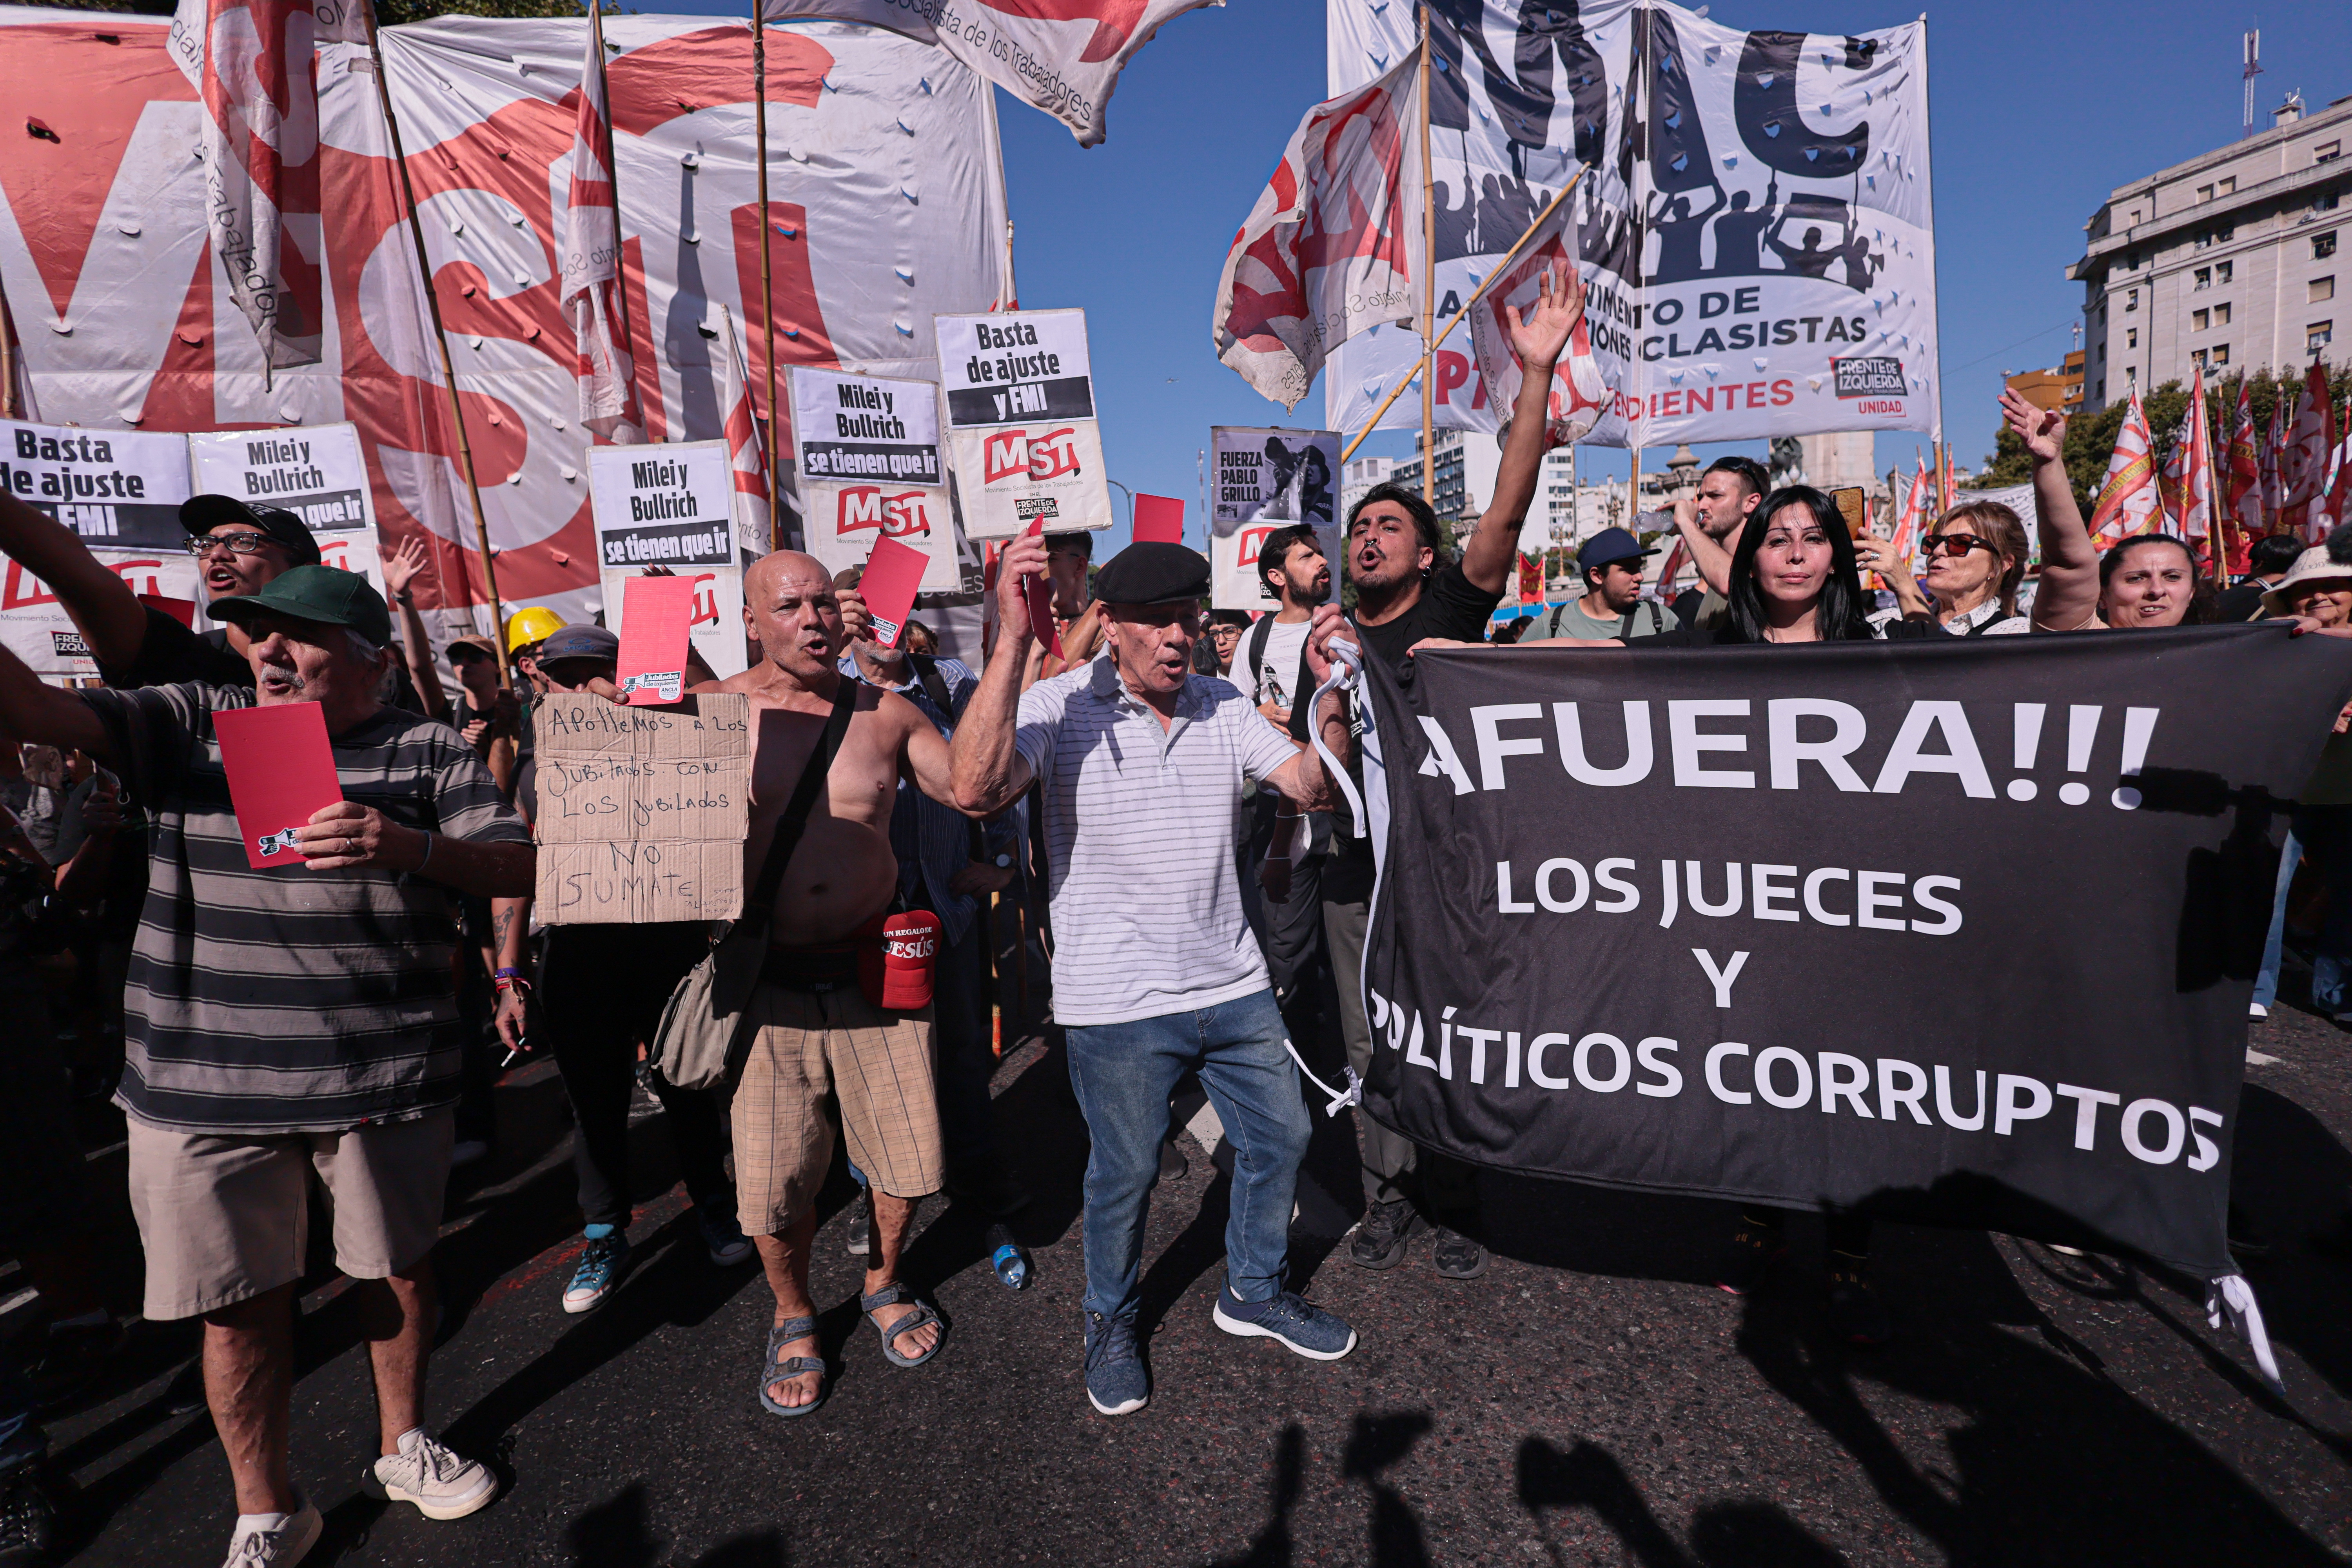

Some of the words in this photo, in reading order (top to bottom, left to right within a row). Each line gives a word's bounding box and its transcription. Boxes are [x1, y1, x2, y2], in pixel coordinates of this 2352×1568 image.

[964, 20, 987, 47] de
[988, 29, 1009, 62] los
[1011, 41, 1092, 121] Trabajadores
[1699, 285, 1760, 319] DE
[976, 321, 1038, 350] Basta
[1638, 316, 1866, 362] CLASISTAS
[967, 356, 993, 383] de
[996, 351, 1060, 384] ajuste
[1838, 358, 1885, 375] FRENTE
[1885, 362, 1897, 375] DE
[1839, 374, 1904, 390] IZQUIERDA
[837, 383, 882, 410] Milei
[883, 392, 893, 415] y
[993, 394, 1006, 421] y
[1008, 383, 1048, 414] FMI
[1858, 400, 1902, 414] UNIDAD
[836, 414, 906, 439] Bullrich
[15, 428, 113, 463] Basta
[247, 438, 298, 466] Milei
[299, 441, 310, 464] y
[991, 433, 1075, 476] MST
[1220, 452, 1263, 467] FUERZA
[632, 459, 676, 489] Milei
[678, 464, 688, 490] y
[807, 452, 828, 473] se
[829, 448, 889, 474] tienen
[889, 454, 922, 478] que
[922, 449, 936, 474] ir
[1221, 469, 1258, 485] PABLO
[41, 466, 145, 502] ajuste
[244, 465, 325, 495] Bullrich
[1221, 486, 1260, 502] GRILLO
[307, 500, 345, 528] que
[343, 495, 362, 521] ir
[630, 491, 698, 522] Bullrich
[844, 492, 927, 534] MST
[1016, 499, 1046, 509] FRENTE
[1018, 506, 1058, 516] IZQUIERDA
[605, 541, 626, 563] se
[625, 534, 681, 561] tienen
[681, 532, 714, 561] que
[713, 526, 728, 554] ir
[880, 632, 892, 640] ANCLA
[1416, 697, 2160, 811] AFUERA!!!
[609, 840, 661, 871] NO
[557, 869, 695, 907] SUMATE
[1496, 857, 1642, 916] LOS
[1657, 858, 1964, 936] JUECES
[895, 927, 925, 936] REGALO
[881, 936, 934, 959] JESÚS
[1691, 947, 1750, 1008] Y
[1371, 987, 1684, 1099] POLÍTICOS
[1703, 1041, 2223, 1172] CORRUPTOS
